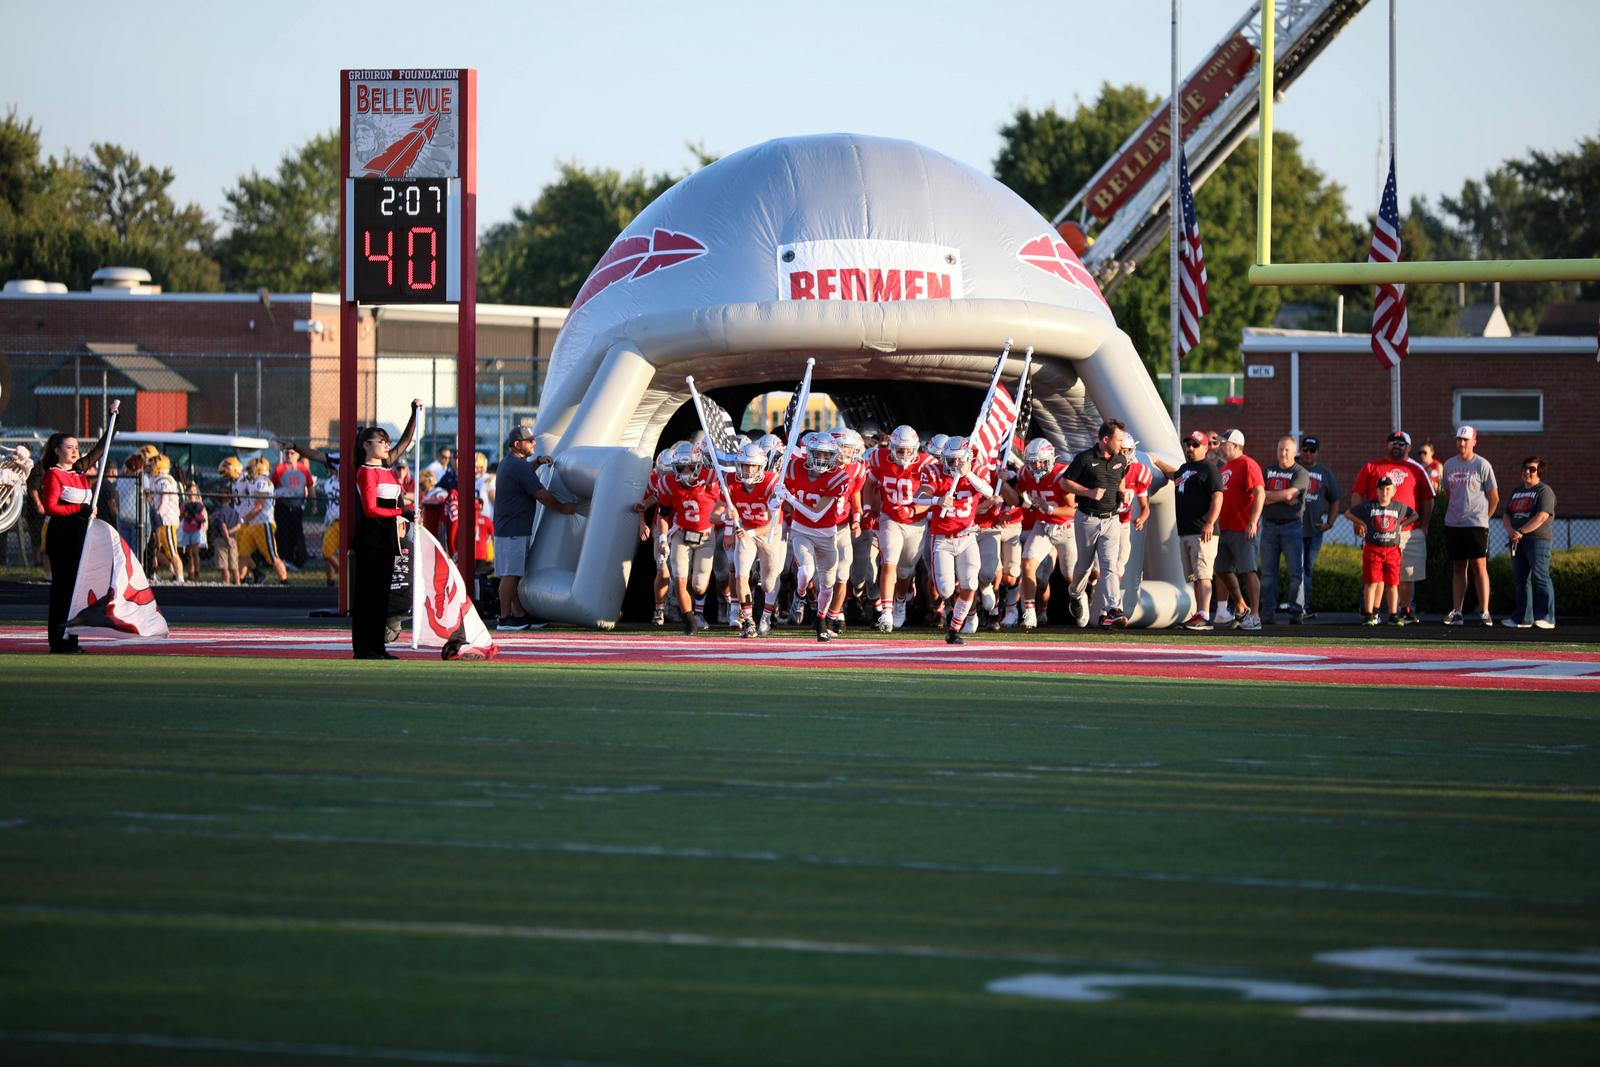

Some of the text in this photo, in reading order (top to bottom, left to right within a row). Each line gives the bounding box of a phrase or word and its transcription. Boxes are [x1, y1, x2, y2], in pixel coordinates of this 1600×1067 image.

[348, 70, 460, 80] GRIDIRON FOUNDATION
[1201, 40, 1241, 83] TOWER
[356, 84, 452, 114] BELLEVUE
[381, 186, 441, 216] 2:07
[364, 226, 437, 290] 40
[883, 476, 913, 506] 50
[682, 499, 700, 522] 2
